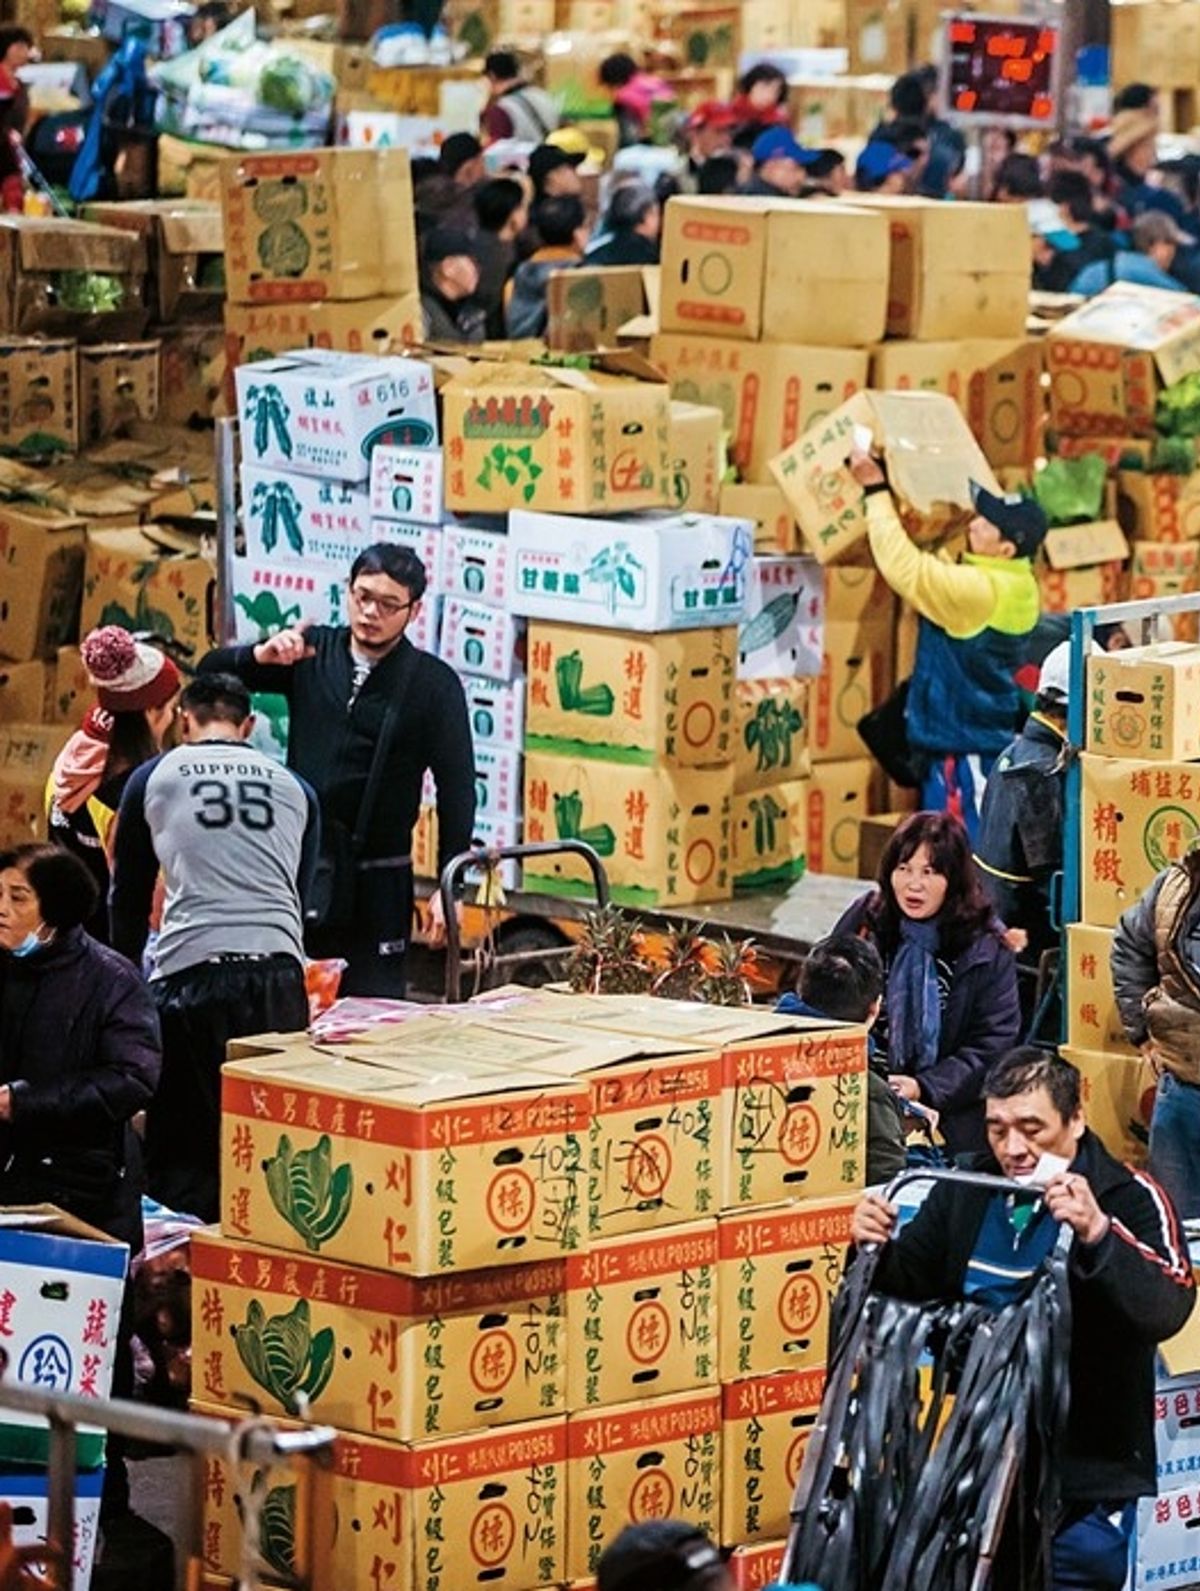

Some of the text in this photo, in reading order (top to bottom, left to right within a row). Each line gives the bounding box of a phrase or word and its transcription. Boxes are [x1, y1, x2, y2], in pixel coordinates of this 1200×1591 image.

[179, 763, 275, 779] SUPPORT
[190, 780, 275, 832] 35
[231, 1123, 255, 1237] 特選
[435, 1146, 458, 1268] 分級包裝
[201, 1287, 227, 1400] 特選
[583, 1284, 604, 1404] 分級包裝
[737, 1256, 757, 1373] 分級包裝
[424, 1314, 447, 1433] 分級包裝
[743, 1415, 765, 1534] 分級包裝
